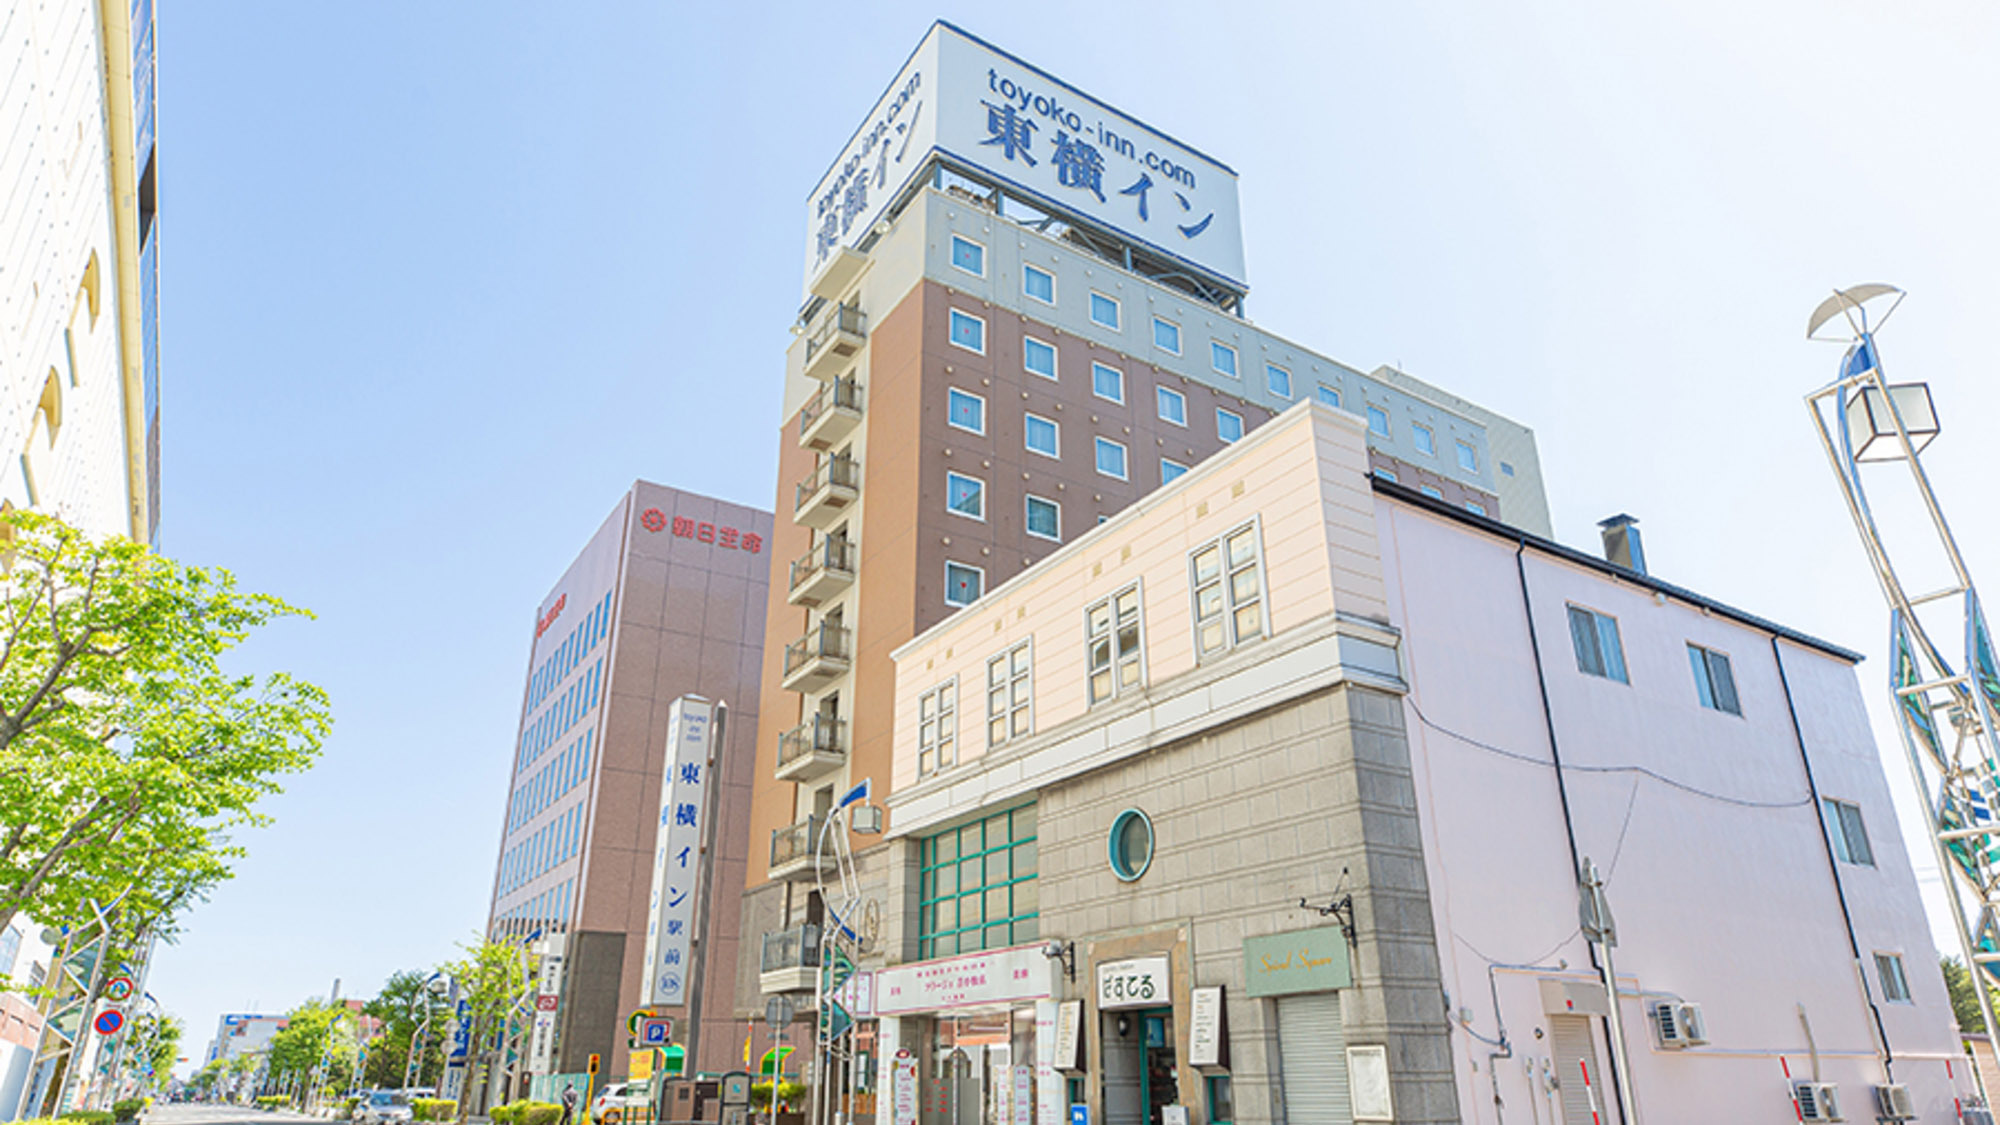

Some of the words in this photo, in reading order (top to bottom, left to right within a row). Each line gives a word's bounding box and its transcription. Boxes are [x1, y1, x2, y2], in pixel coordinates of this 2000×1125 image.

[978, 99, 1214, 239] 東横イン
[987, 68, 1196, 189] toyoko-inn.com
[672, 514, 763, 554] 朝日生命
